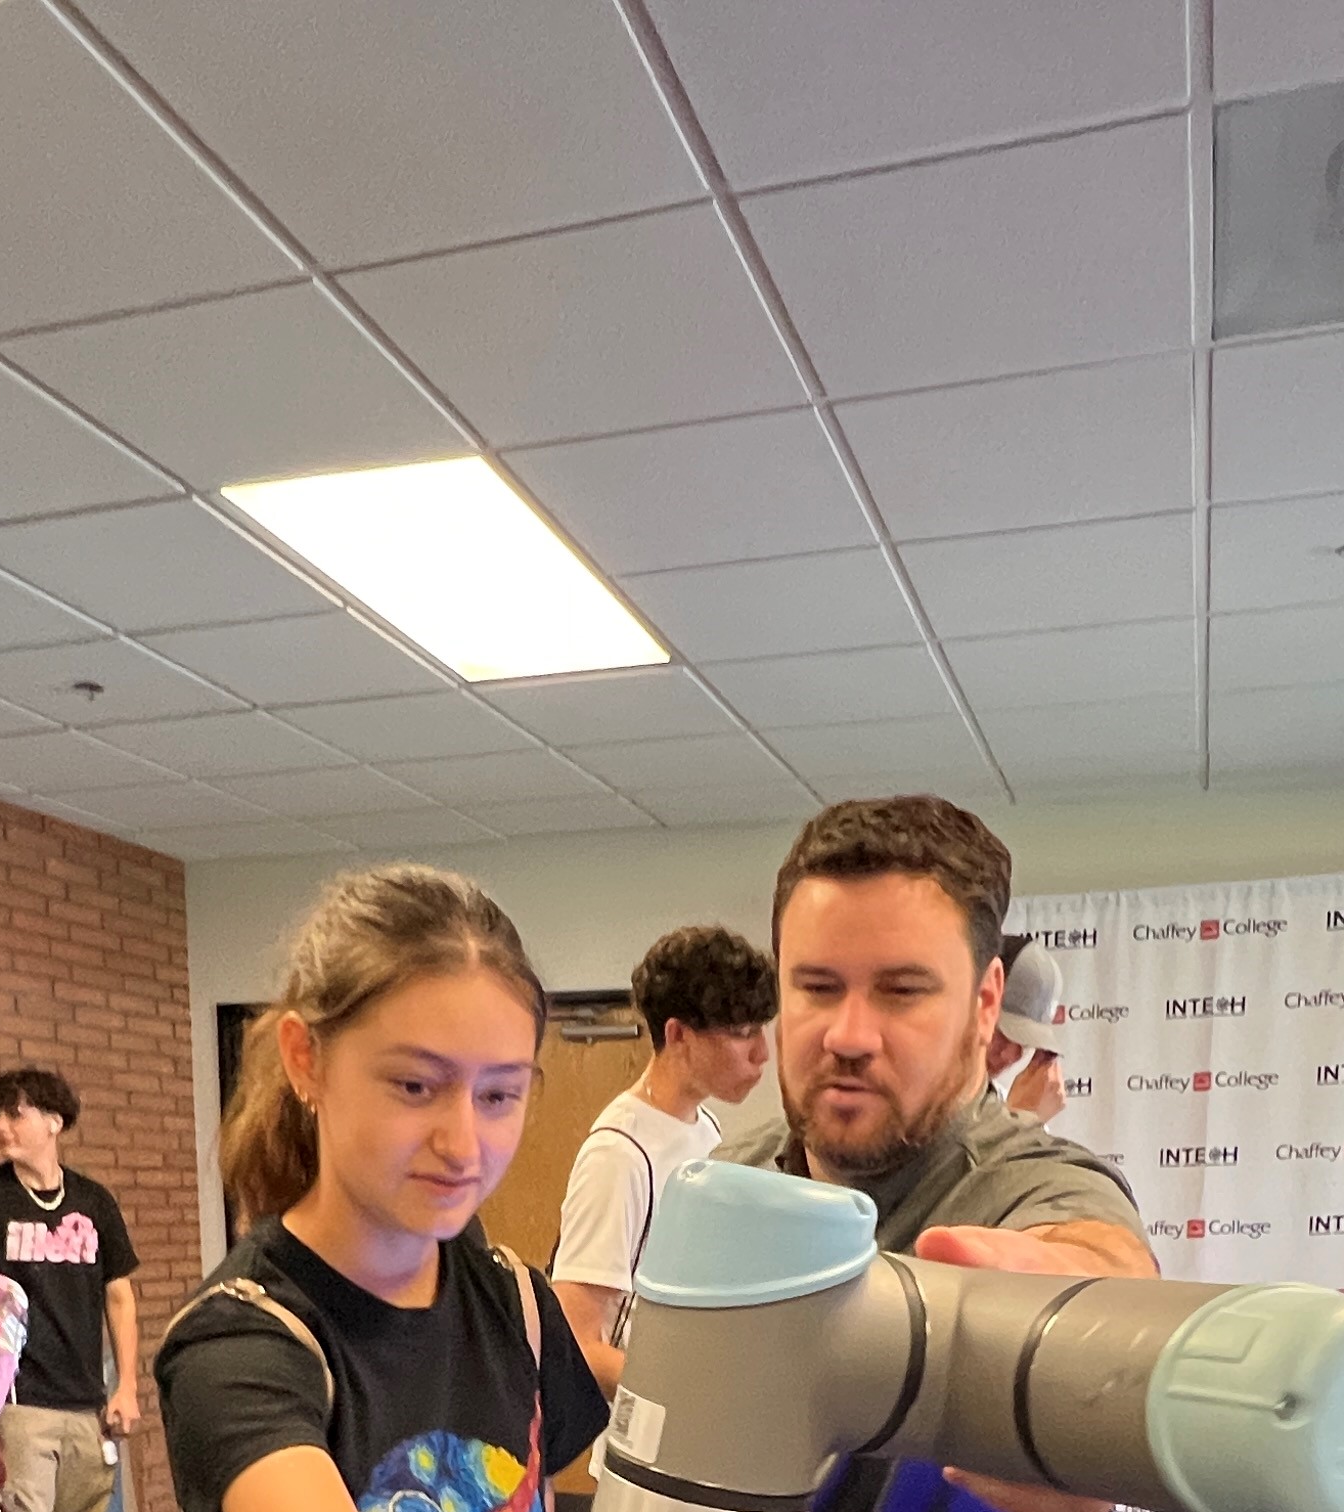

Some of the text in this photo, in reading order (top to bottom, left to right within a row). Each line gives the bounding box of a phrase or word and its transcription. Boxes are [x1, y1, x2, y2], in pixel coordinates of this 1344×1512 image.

[1133, 918, 1288, 943] Chaffey College
[1068, 1004, 1129, 1024] College
[1127, 1071, 1279, 1094] Chaffey College
[1276, 1142, 1341, 1163] Chaffey
[1208, 1218, 1271, 1239] College
